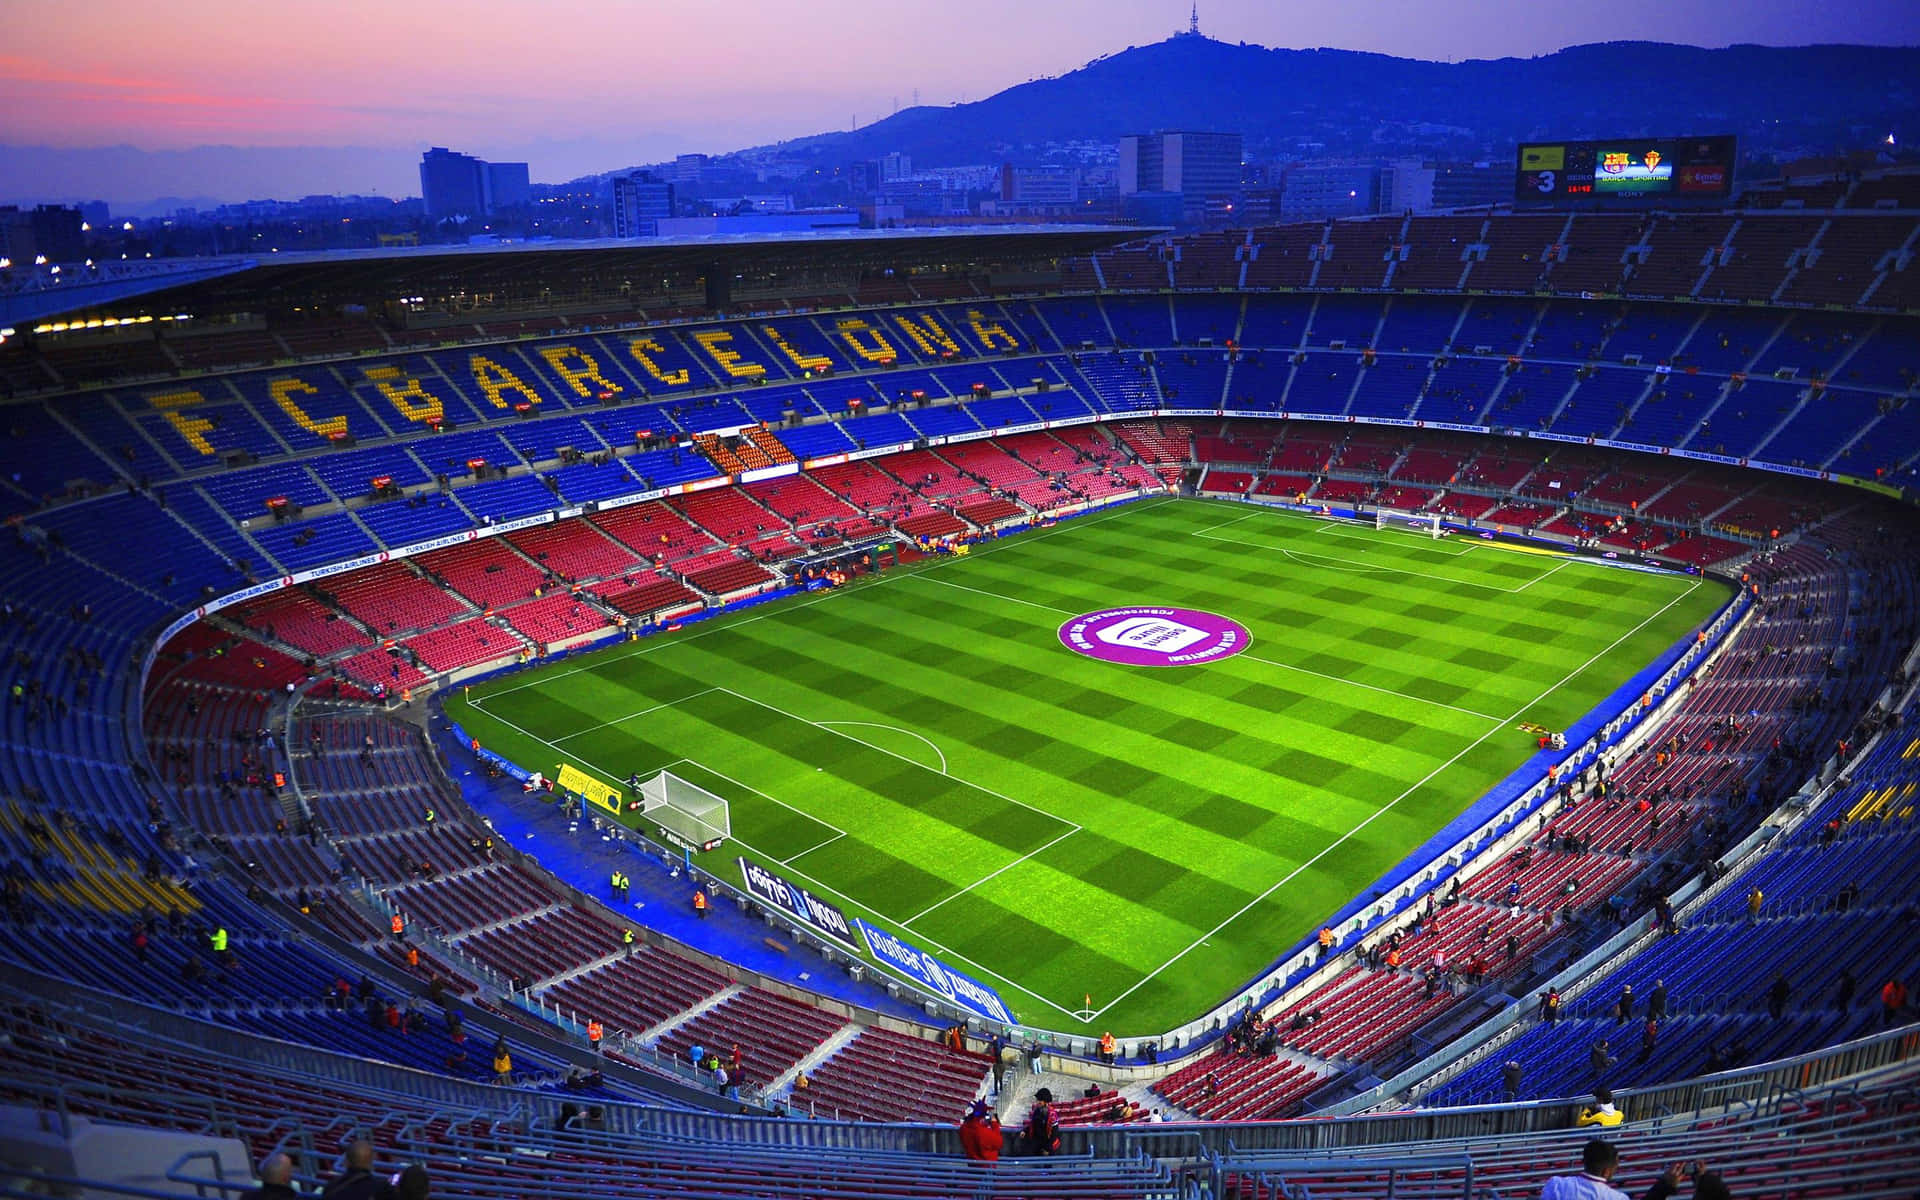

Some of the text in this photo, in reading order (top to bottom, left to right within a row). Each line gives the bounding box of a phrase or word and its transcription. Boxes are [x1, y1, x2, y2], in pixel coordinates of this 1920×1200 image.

[1537, 171, 1556, 192] 3
[364, 309, 1021, 422] BARCELONA
[610, 490, 660, 506] TURKISH AIRLINES
[492, 515, 548, 533] TURKISH AIRLINES
[406, 534, 465, 554] TURKISH AIRLINES
[311, 556, 376, 577] TURKISH AIRLINES
[1129, 625, 1170, 642] lliure
[1143, 627, 1187, 648] seient
[804, 890, 850, 935] mobily
[867, 928, 1011, 1025] Allianz Seguros
